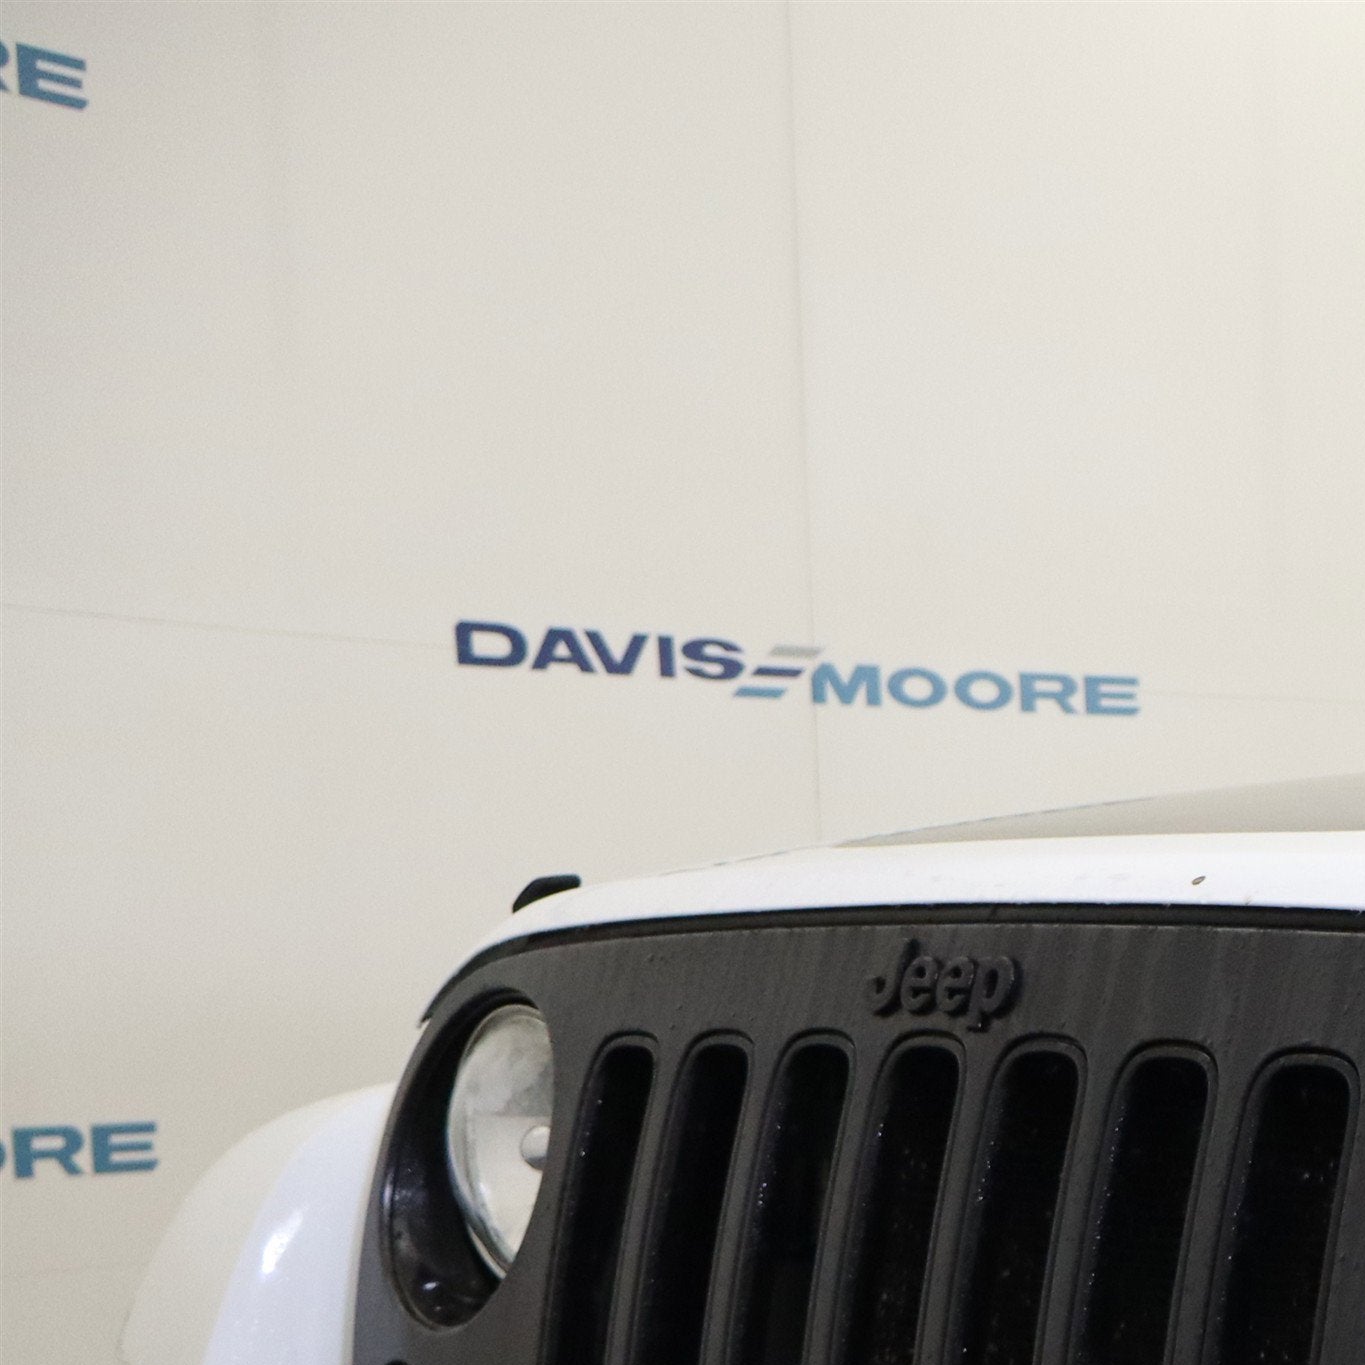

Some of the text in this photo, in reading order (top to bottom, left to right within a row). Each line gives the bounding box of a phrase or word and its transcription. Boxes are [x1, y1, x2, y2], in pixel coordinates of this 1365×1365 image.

[0, 41, 89, 110] E
[455, 619, 1140, 717] DAVIS MOORE
[863, 938, 1022, 1032] Jeep
